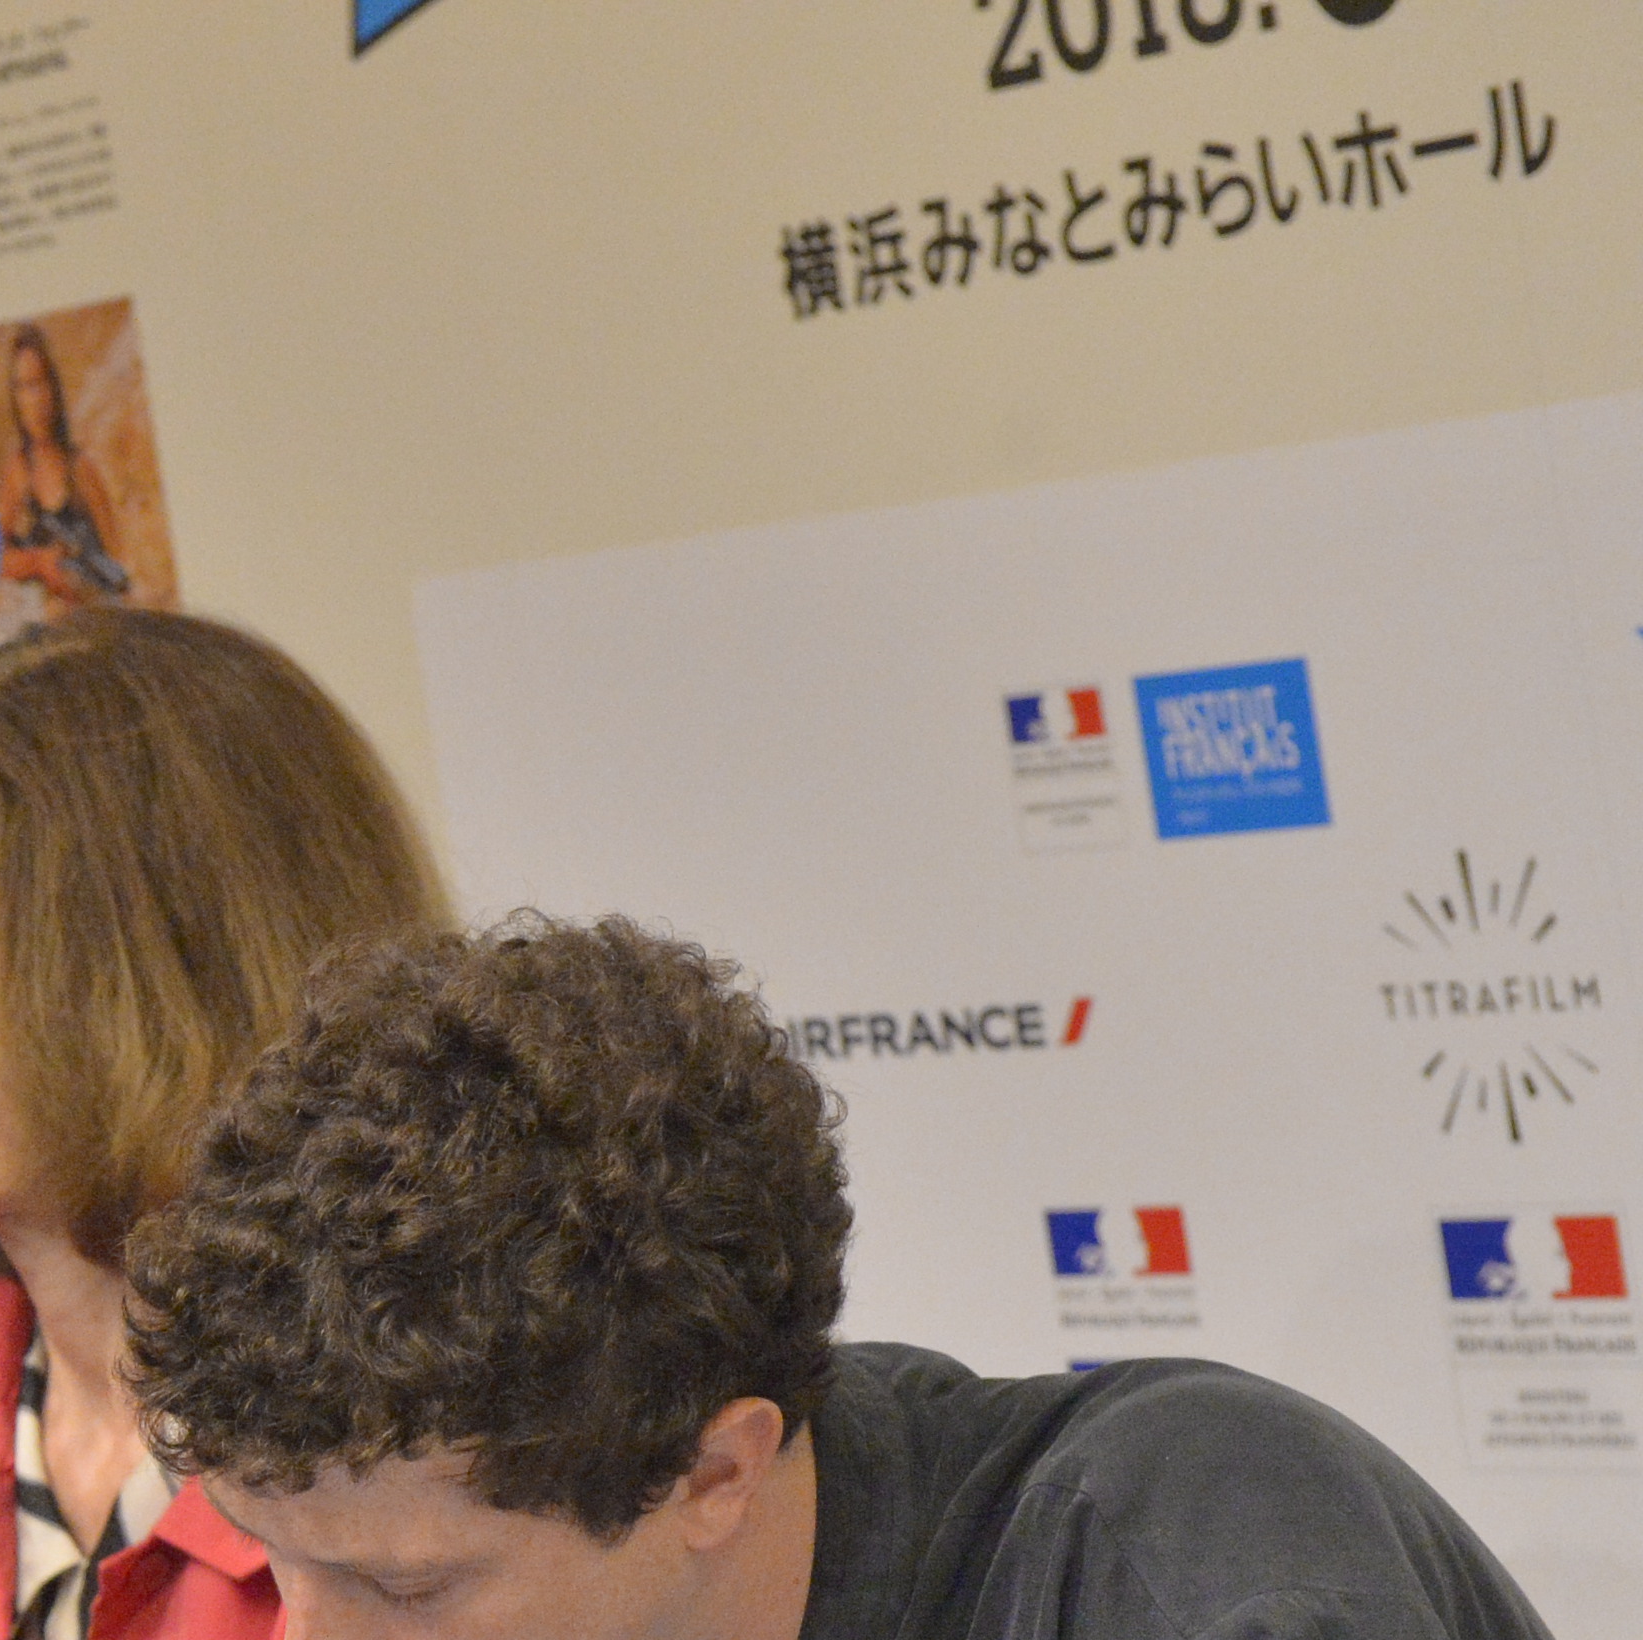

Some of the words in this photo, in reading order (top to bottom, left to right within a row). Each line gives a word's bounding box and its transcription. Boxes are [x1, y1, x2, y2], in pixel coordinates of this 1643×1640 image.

[778, 81, 1557, 320] 横浜みなとみらいホール
[1154, 685, 1279, 731] INSTITUT
[1160, 721, 1301, 787] FRANÇAIS
[1380, 975, 1603, 1022] TITRAFILM
[789, 1002, 1047, 1059] IRFRANCE
